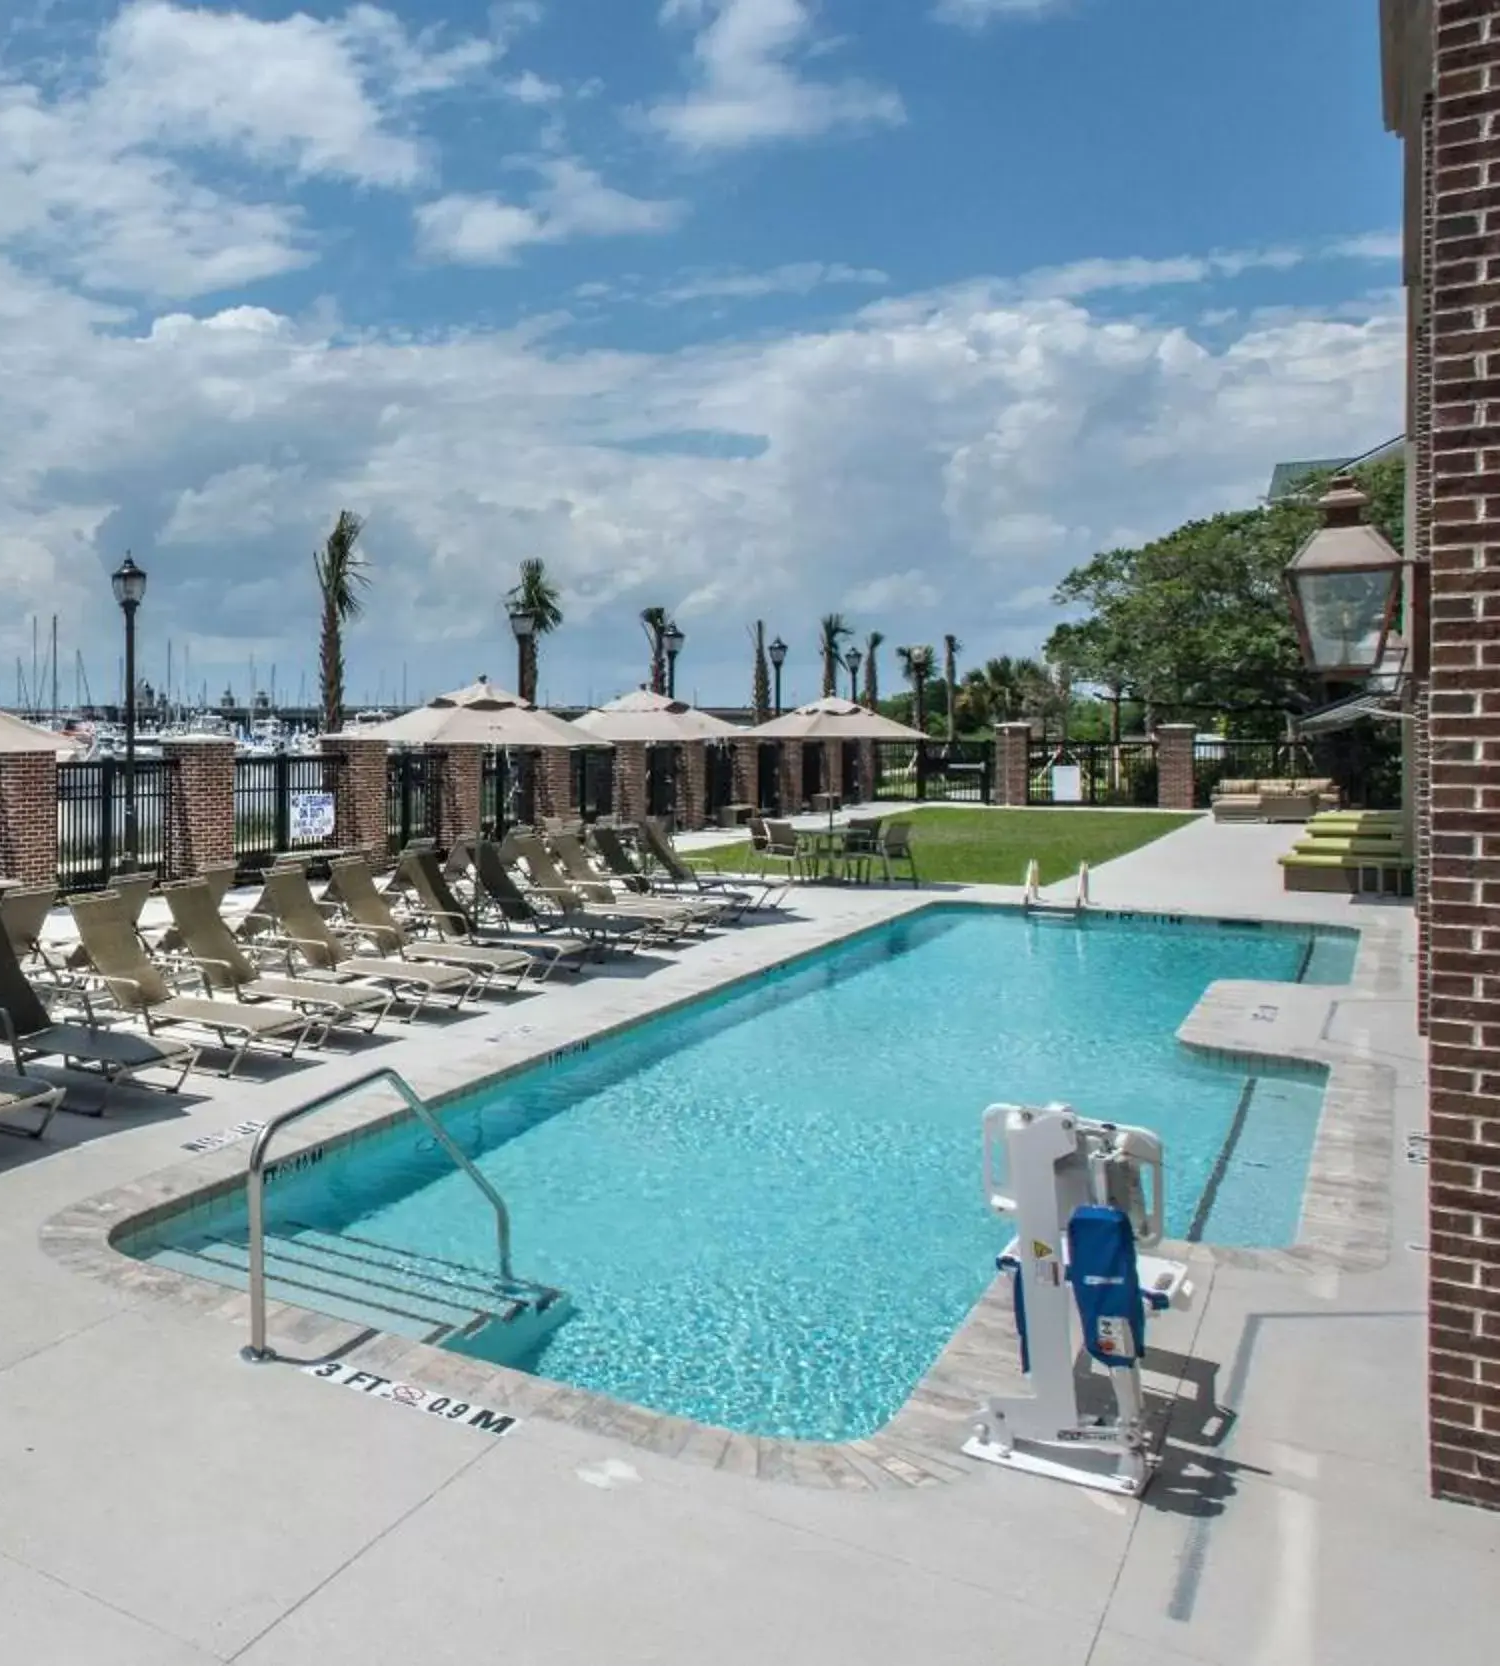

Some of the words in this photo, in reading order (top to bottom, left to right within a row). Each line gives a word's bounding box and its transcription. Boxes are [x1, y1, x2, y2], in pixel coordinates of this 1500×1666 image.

[315, 1363, 342, 1377] 3
[428, 1397, 470, 1419] 0.9
[468, 1409, 516, 1435] M
